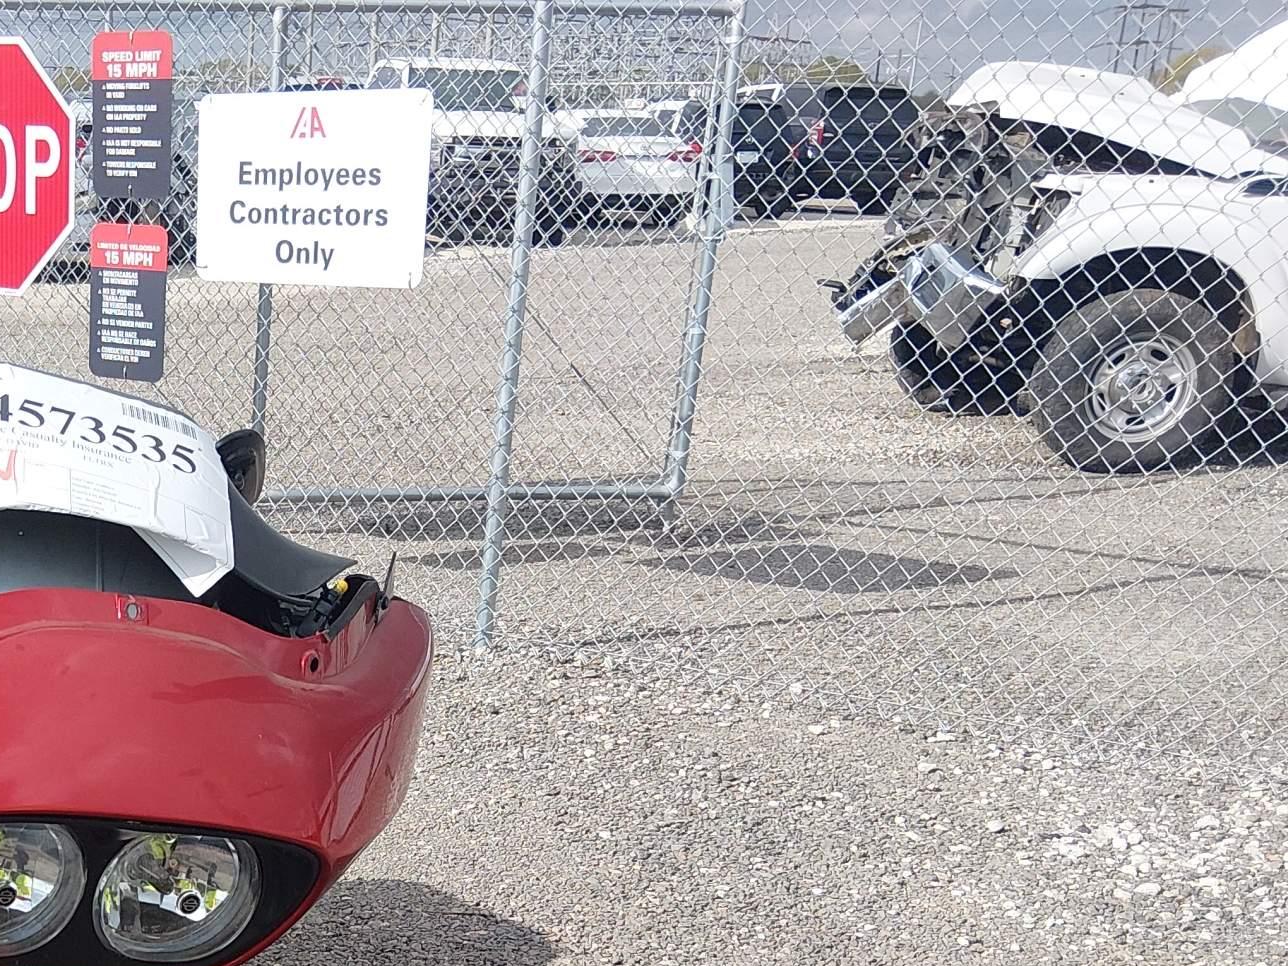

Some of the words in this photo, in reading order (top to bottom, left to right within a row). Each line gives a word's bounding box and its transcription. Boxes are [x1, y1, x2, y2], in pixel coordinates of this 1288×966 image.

[102, 51, 133, 62] SPEED
[135, 50, 161, 62] LIMIT
[107, 63, 122, 78] 15
[125, 62, 158, 78] MPH
[238, 161, 382, 191] Employees
[229, 200, 389, 227] Contractors
[105, 251, 119, 265] 15
[123, 252, 153, 267] MPH
[275, 240, 335, 271] Only
